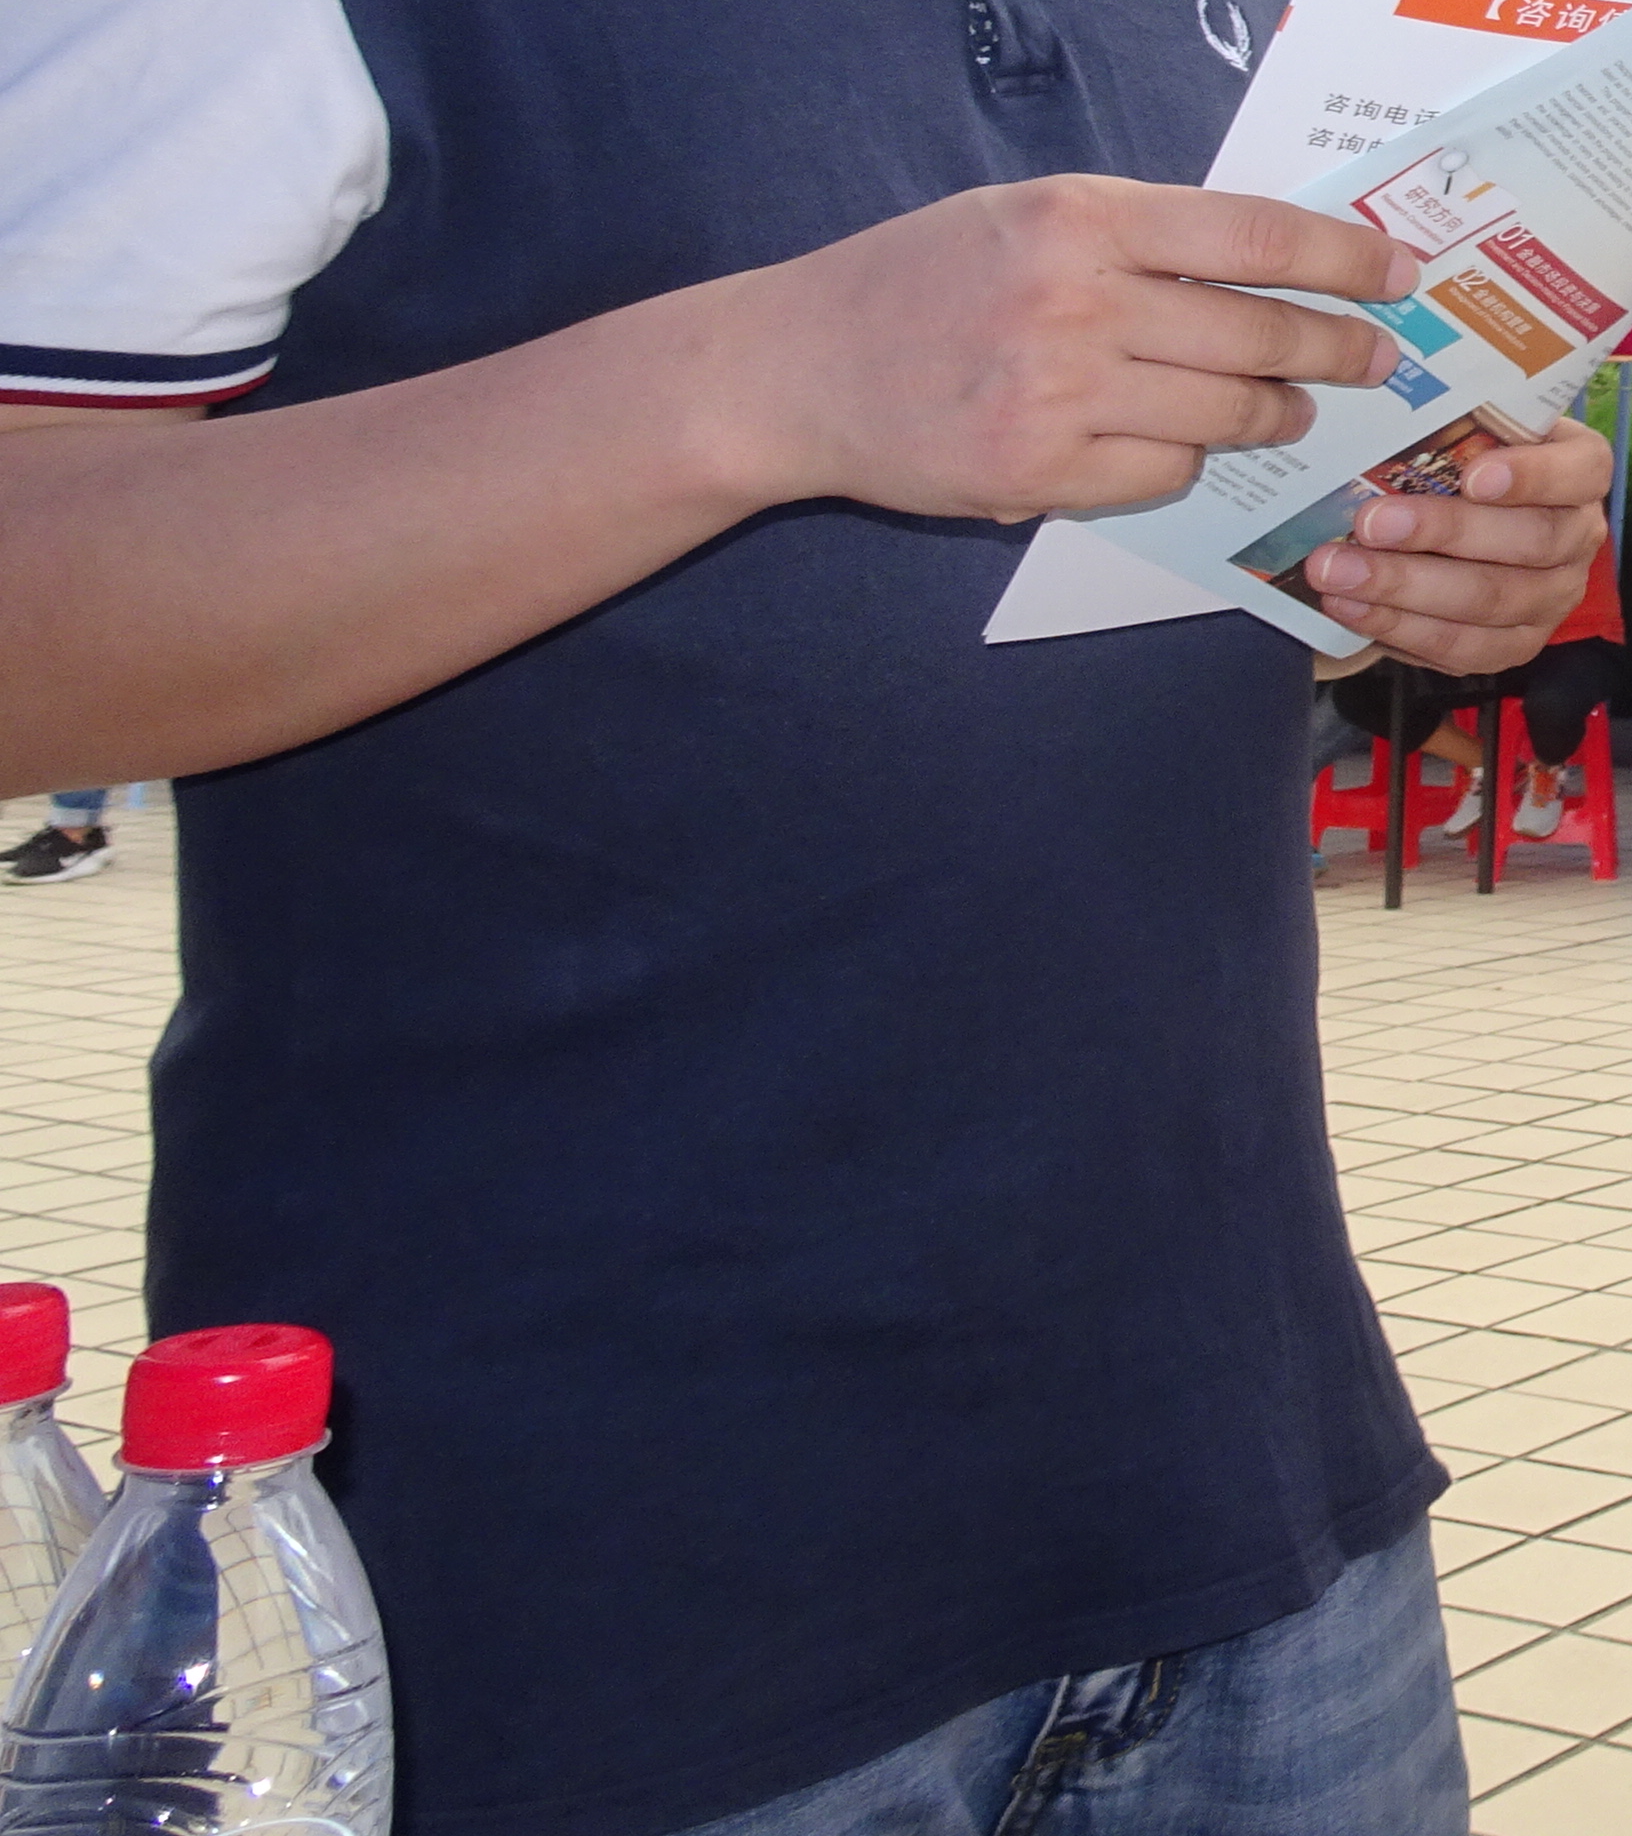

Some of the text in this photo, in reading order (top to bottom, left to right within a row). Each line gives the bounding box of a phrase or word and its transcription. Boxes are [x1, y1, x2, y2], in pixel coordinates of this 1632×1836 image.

[1307, 128, 1384, 154] 咨询
[1403, 183, 1466, 234] 研究方向
